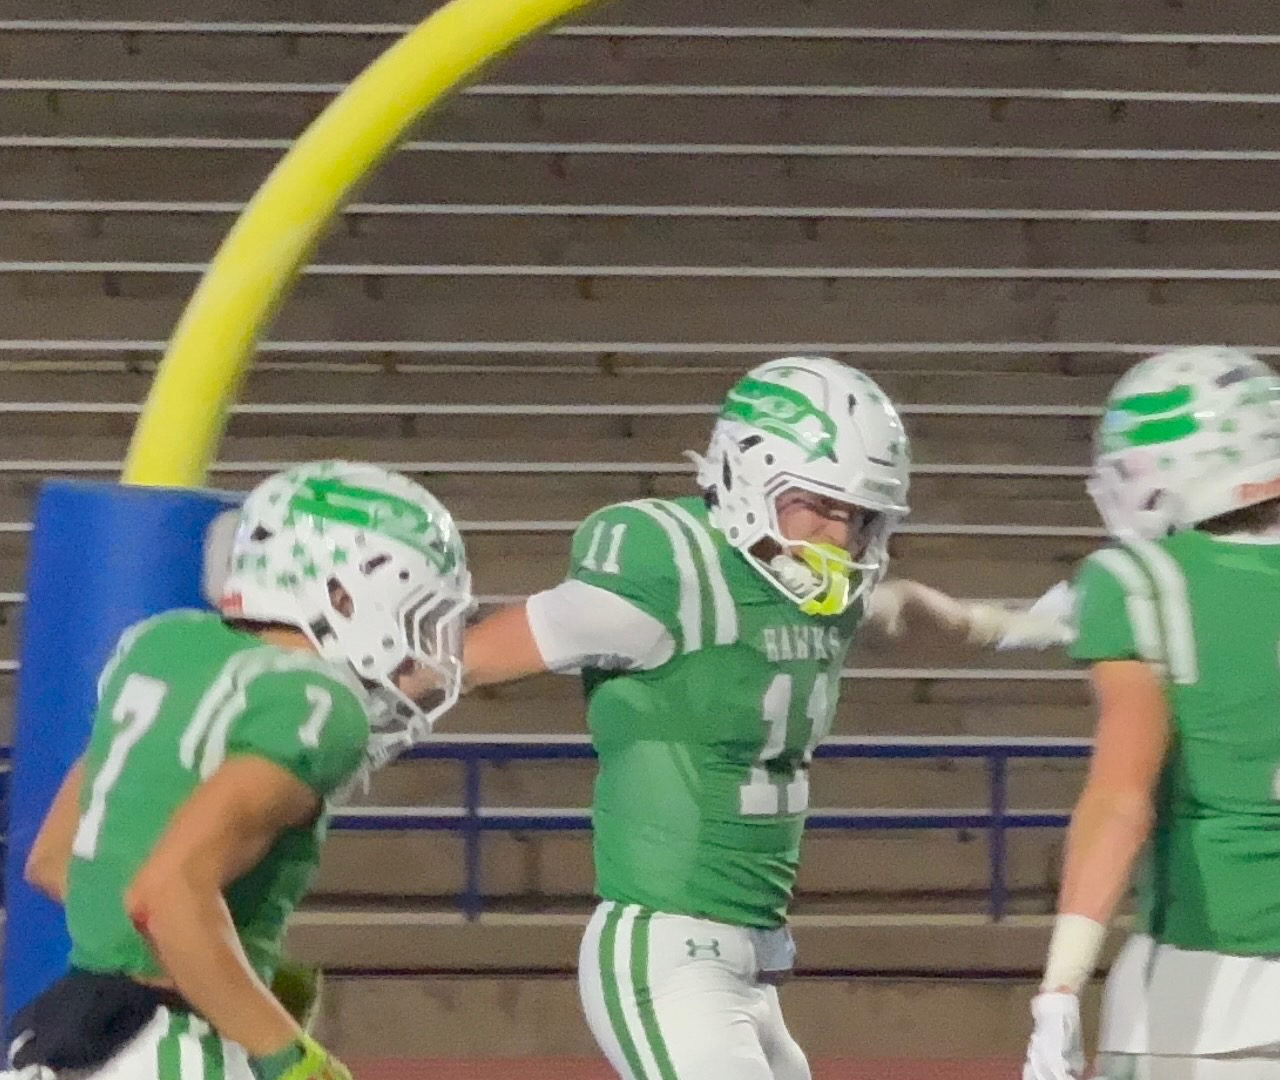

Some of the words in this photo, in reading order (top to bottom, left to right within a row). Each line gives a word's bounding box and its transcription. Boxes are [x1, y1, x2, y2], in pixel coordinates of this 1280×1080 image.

[582, 521, 628, 574] 11
[72, 672, 167, 861] 7
[297, 684, 333, 748] 7
[740, 673, 828, 816] 11
